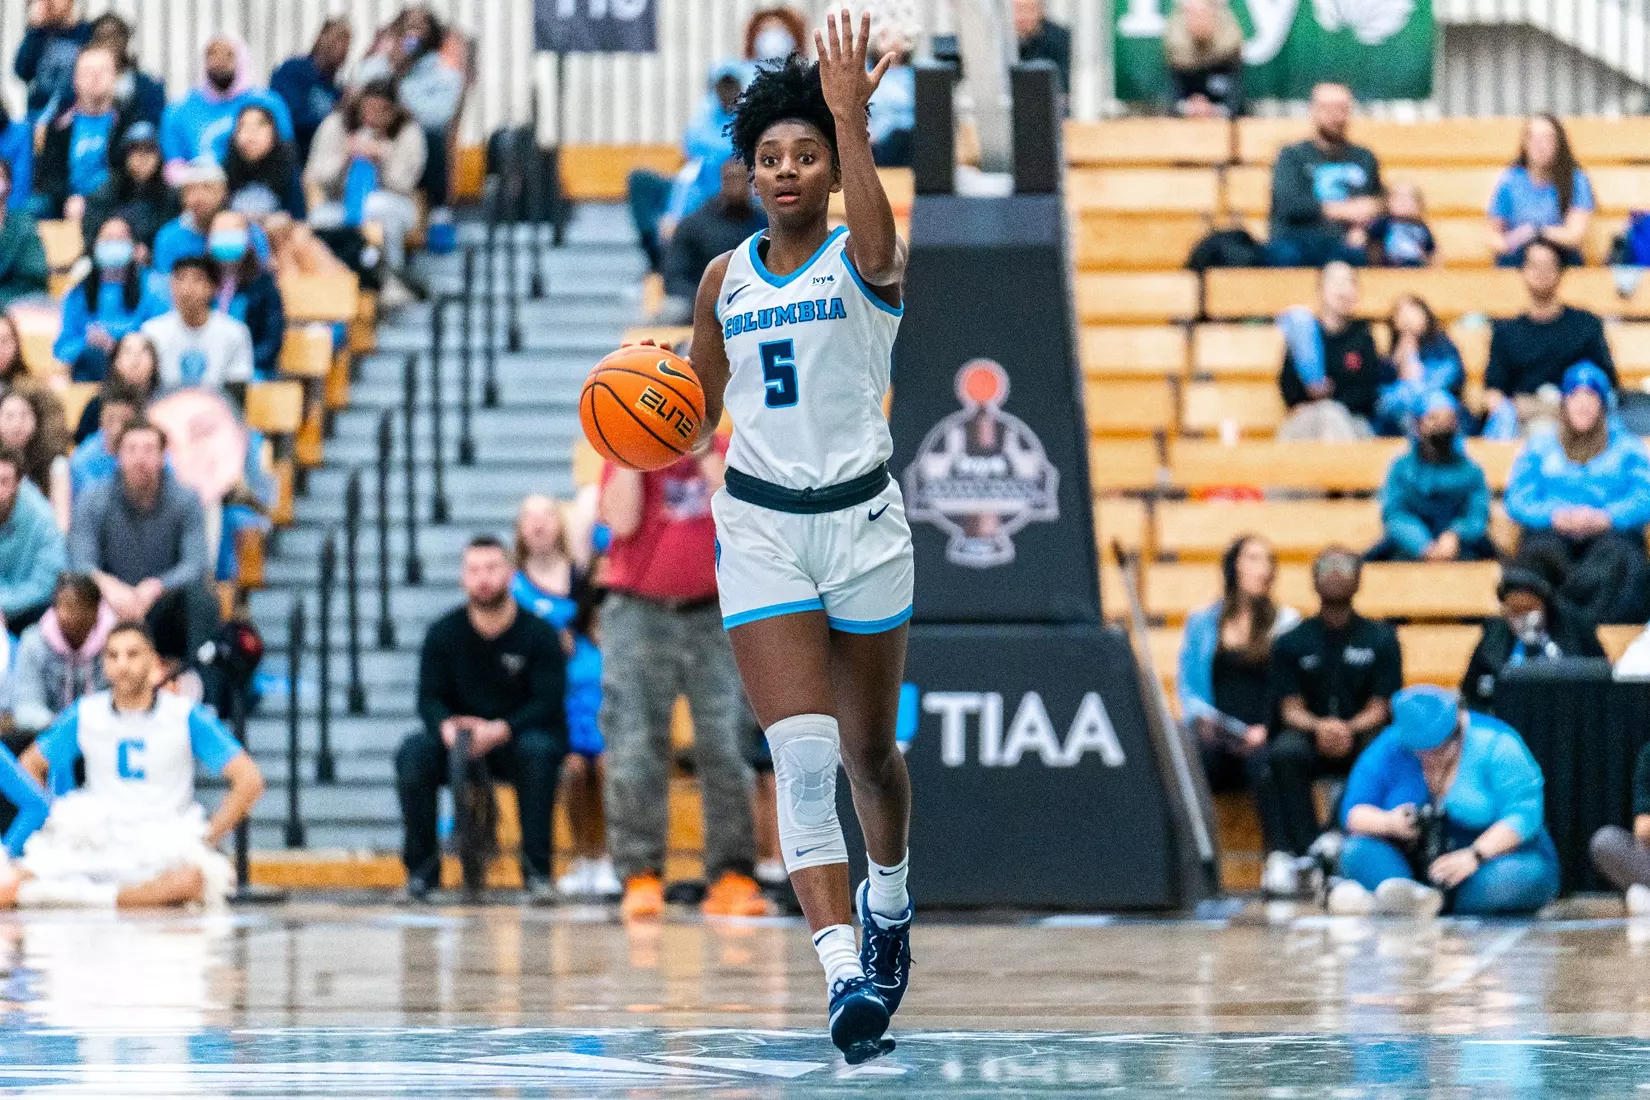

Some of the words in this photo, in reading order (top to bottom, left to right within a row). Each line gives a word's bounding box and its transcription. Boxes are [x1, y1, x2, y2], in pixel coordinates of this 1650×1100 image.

[812, 276, 826, 285] Ivy
[724, 298, 847, 340] COLUMBIA
[759, 338, 799, 409] 5
[638, 385, 696, 438] ELITE
[922, 691, 1126, 767] TIAA
[118, 738, 145, 779] C
